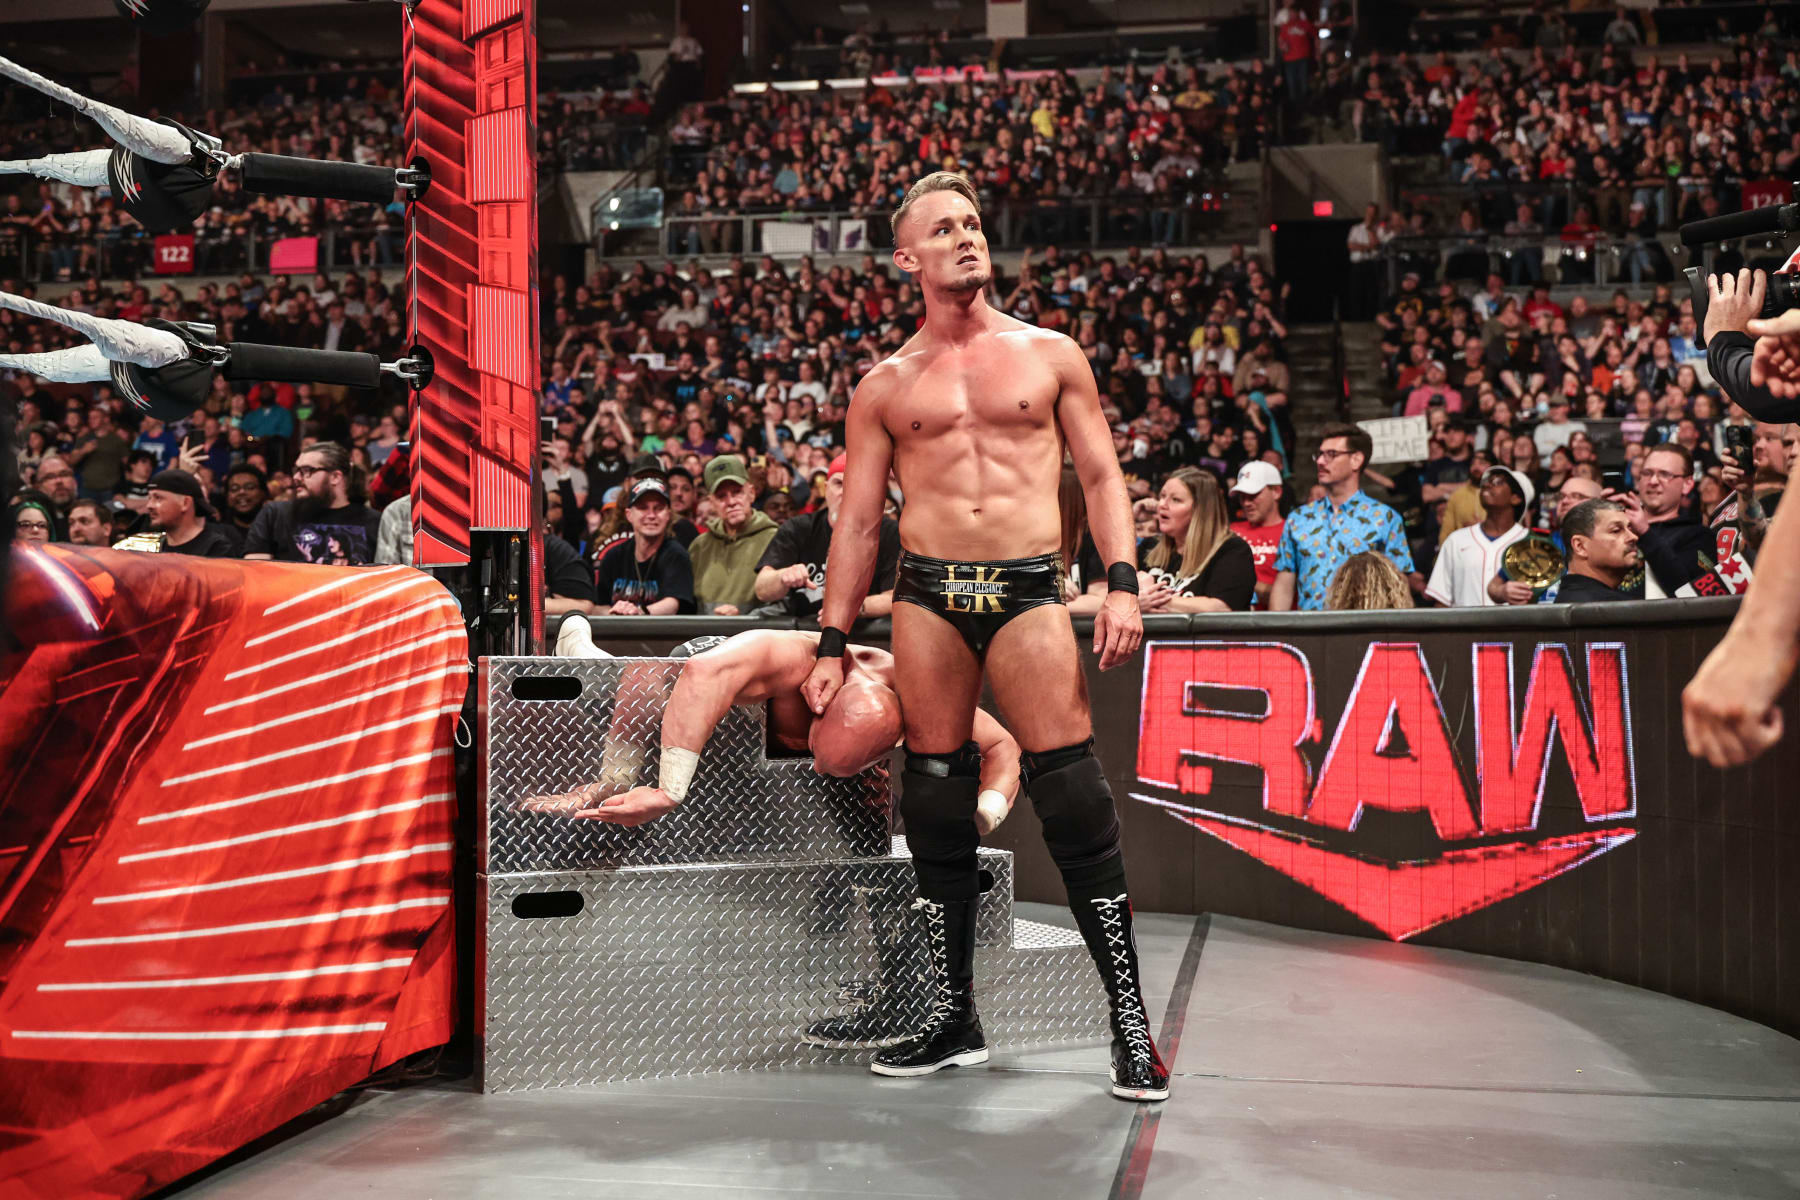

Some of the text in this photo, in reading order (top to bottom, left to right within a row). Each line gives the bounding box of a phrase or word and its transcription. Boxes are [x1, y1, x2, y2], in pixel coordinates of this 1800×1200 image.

[161, 246, 190, 262] 122
[945, 582, 1003, 594] EUROPEAN ELEGANCE
[1136, 640, 1637, 841] RAW
